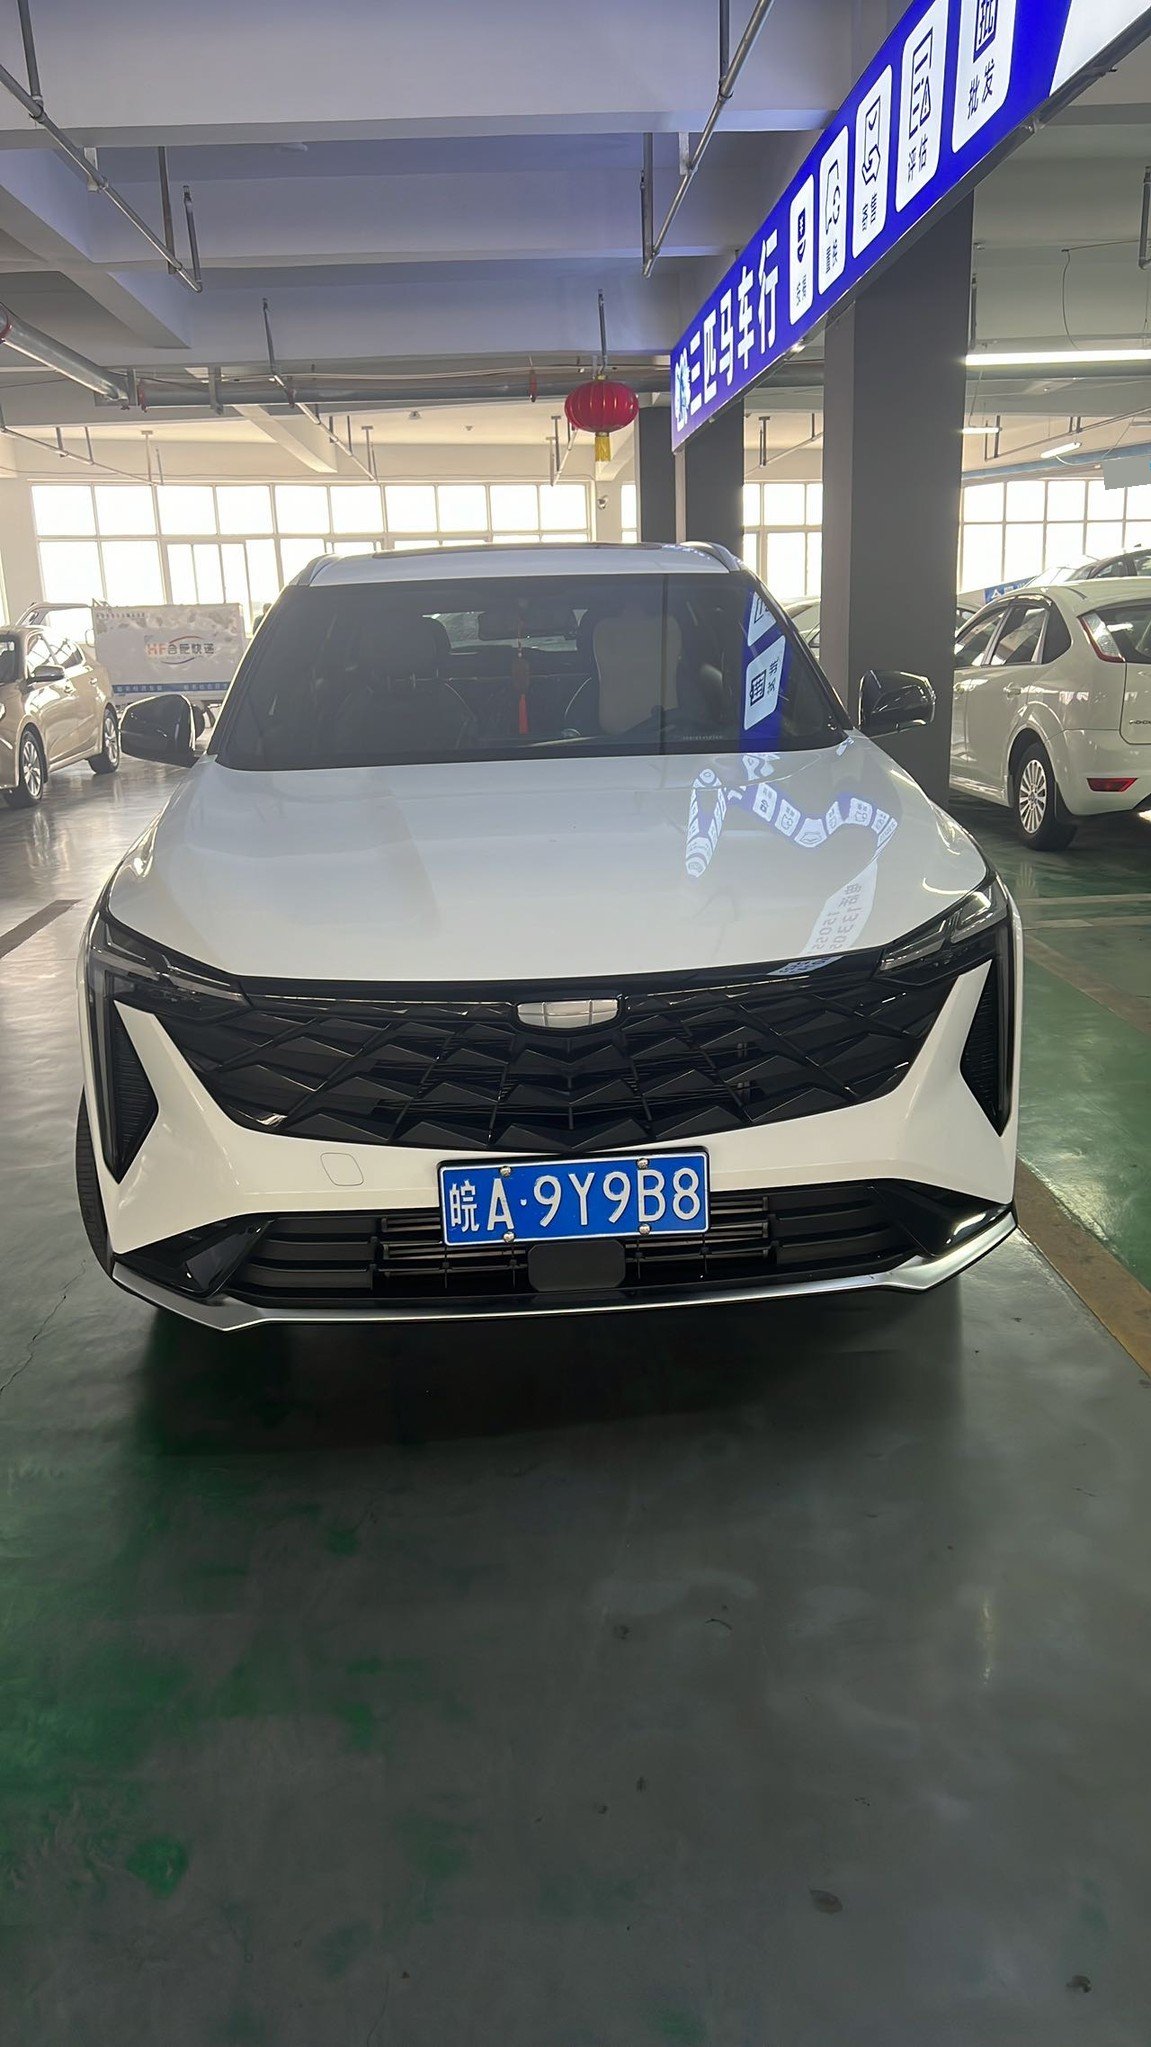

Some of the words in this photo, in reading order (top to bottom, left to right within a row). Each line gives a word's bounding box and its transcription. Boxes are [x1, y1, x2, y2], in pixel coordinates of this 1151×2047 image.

[967, 58, 995, 120] 批发
[907, 134, 929, 183] 评估
[690, 229, 779, 416] 三匹马车行
[449, 1167, 701, 1233] 皖A·9Y9B8
